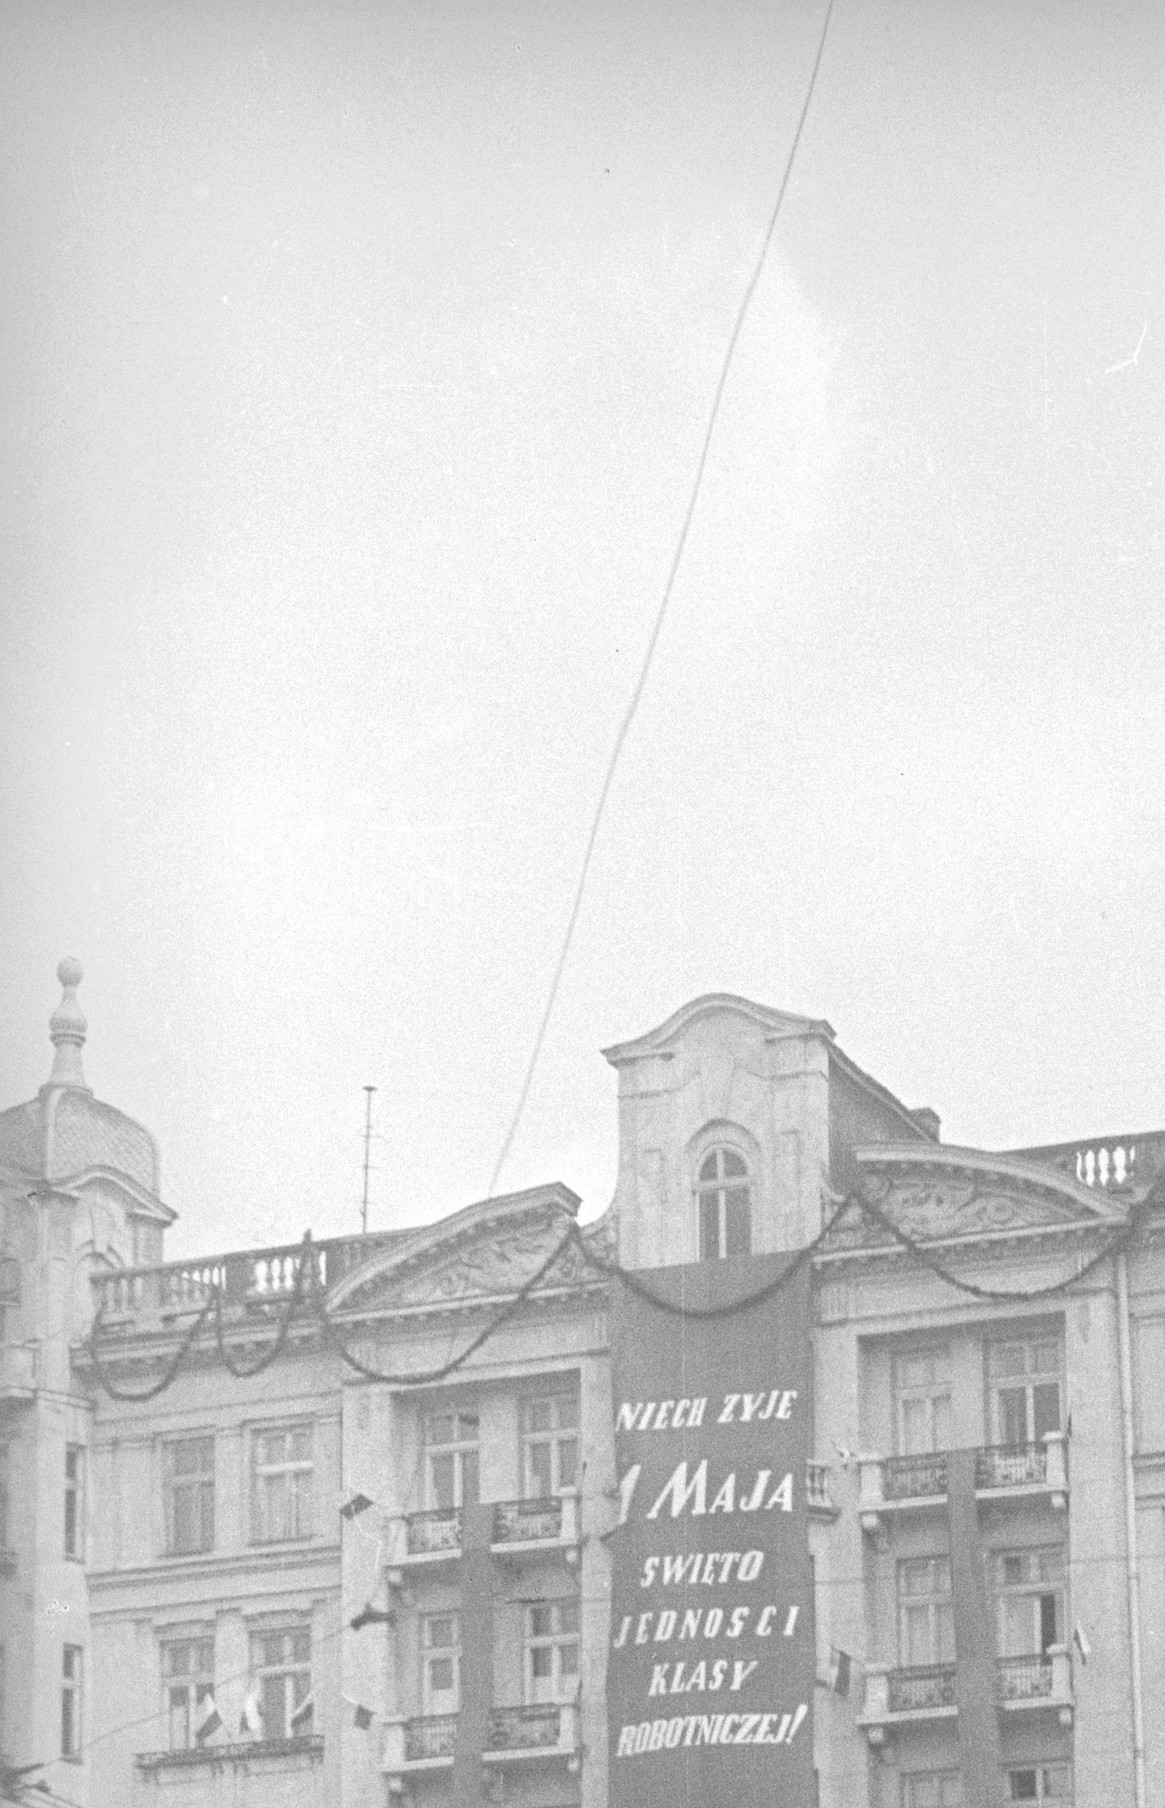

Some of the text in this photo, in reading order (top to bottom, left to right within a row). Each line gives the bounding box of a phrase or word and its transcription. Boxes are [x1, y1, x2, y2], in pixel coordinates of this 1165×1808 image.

[616, 1389, 798, 1432] NIECH ZYJE
[618, 1459, 794, 1524] 1 MAJA
[649, 1659, 759, 1696] KLASY
[616, 1704, 808, 1757] ROBOTNICZEJ!
